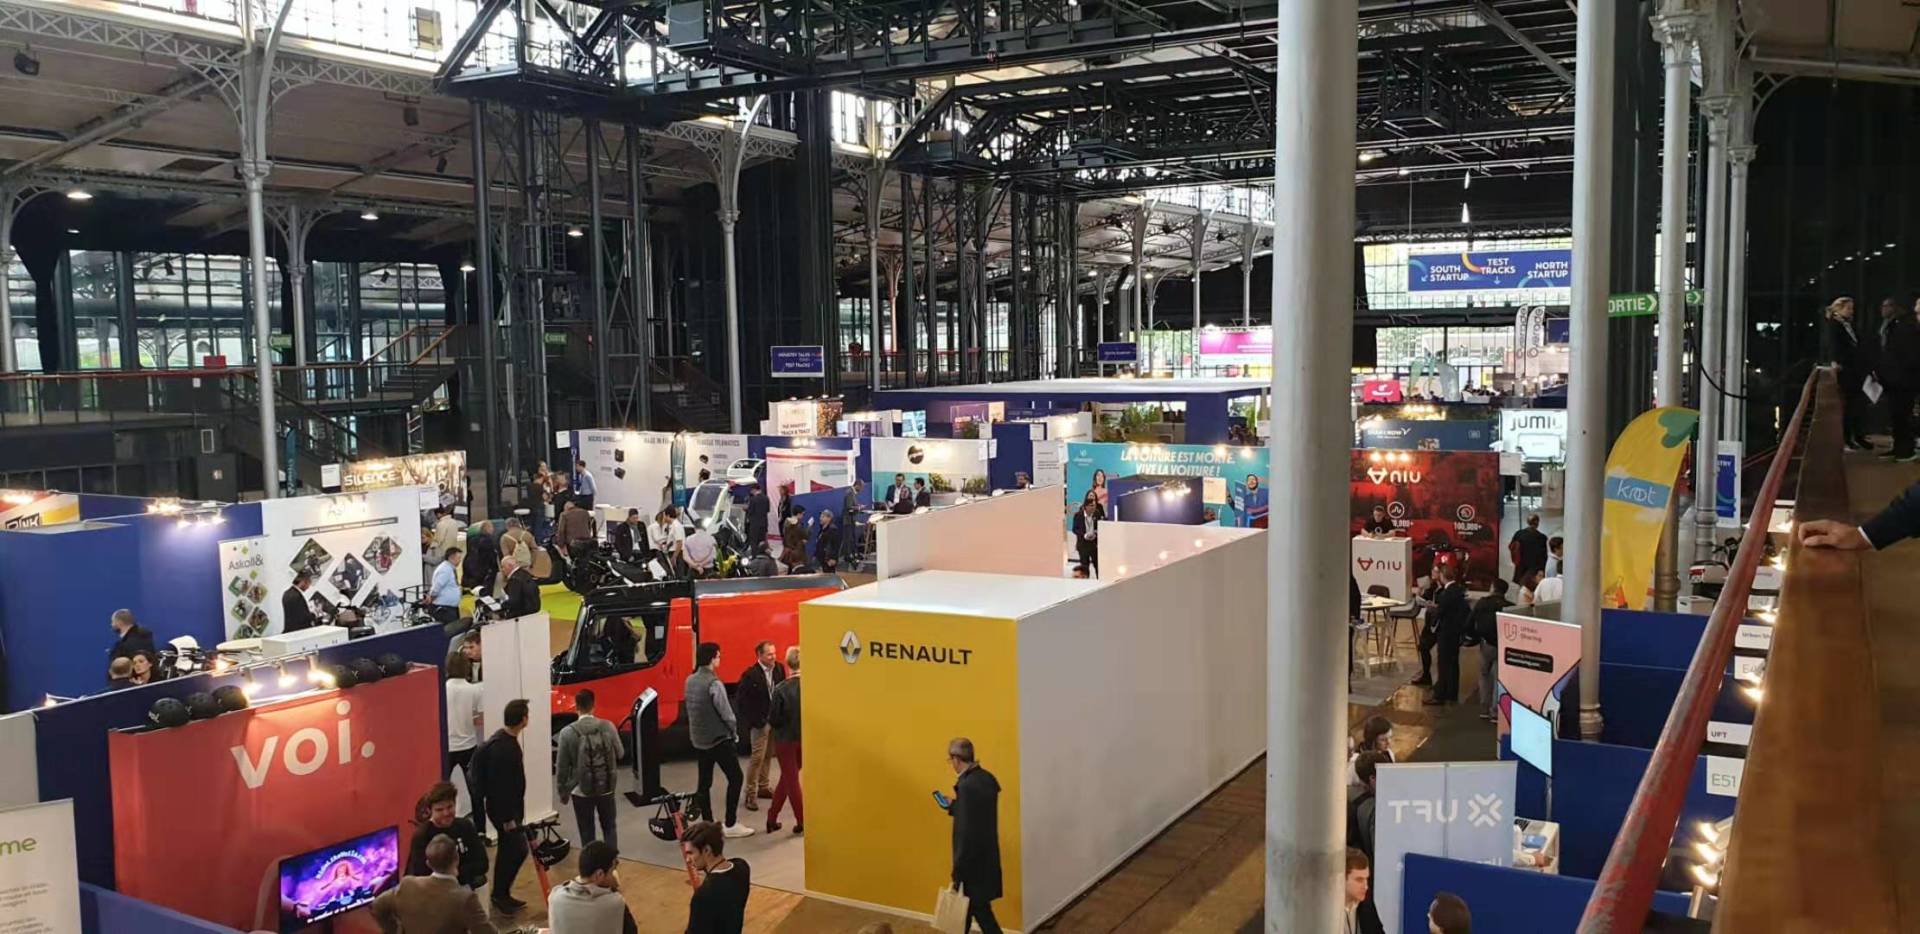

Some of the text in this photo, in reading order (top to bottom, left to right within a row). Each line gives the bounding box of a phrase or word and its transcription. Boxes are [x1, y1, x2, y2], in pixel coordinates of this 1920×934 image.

[1487, 258, 1509, 266] TEST
[1535, 261, 1568, 270] NORTH
[1430, 265, 1461, 274] SOUTH
[1480, 266, 1516, 275] TRACKS
[1527, 270, 1568, 279] STARTUP
[1430, 273, 1469, 283] STARTUP
[1608, 297, 1646, 313] ORTIE
[1121, 450, 1132, 461] LA
[1177, 451, 1194, 462] EST
[1135, 463, 1156, 475] VIVE
[1157, 464, 1170, 475] LA
[1170, 464, 1214, 477] VOITURE
[343, 471, 397, 487] SILENCE
[870, 641, 972, 665] RENAULT
[1711, 731, 1727, 739] UFT
[230, 700, 375, 790] voi.
[1711, 774, 1737, 788] E51
[0, 838, 37, 857] me
